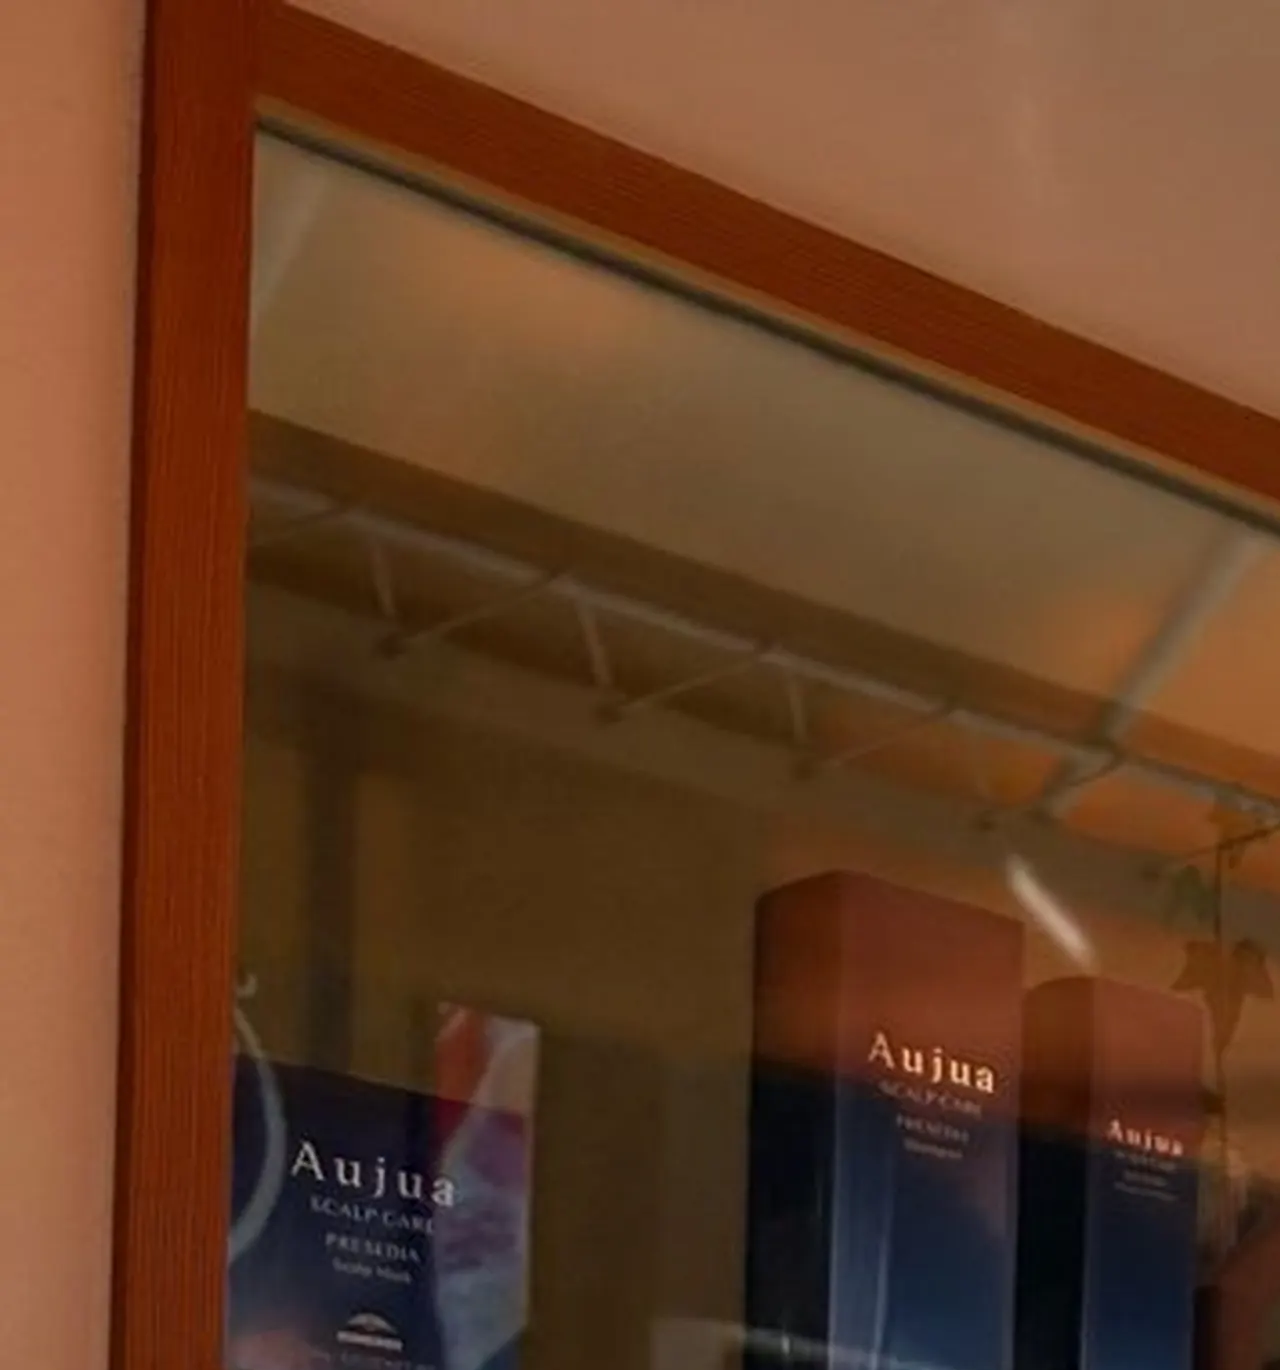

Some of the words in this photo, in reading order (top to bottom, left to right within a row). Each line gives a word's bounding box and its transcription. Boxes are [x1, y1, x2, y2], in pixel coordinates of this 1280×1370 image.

[867, 1029, 995, 1094] Aujua
[1106, 1117, 1184, 1156] Aujua
[290, 1139, 457, 1208] Aujua
